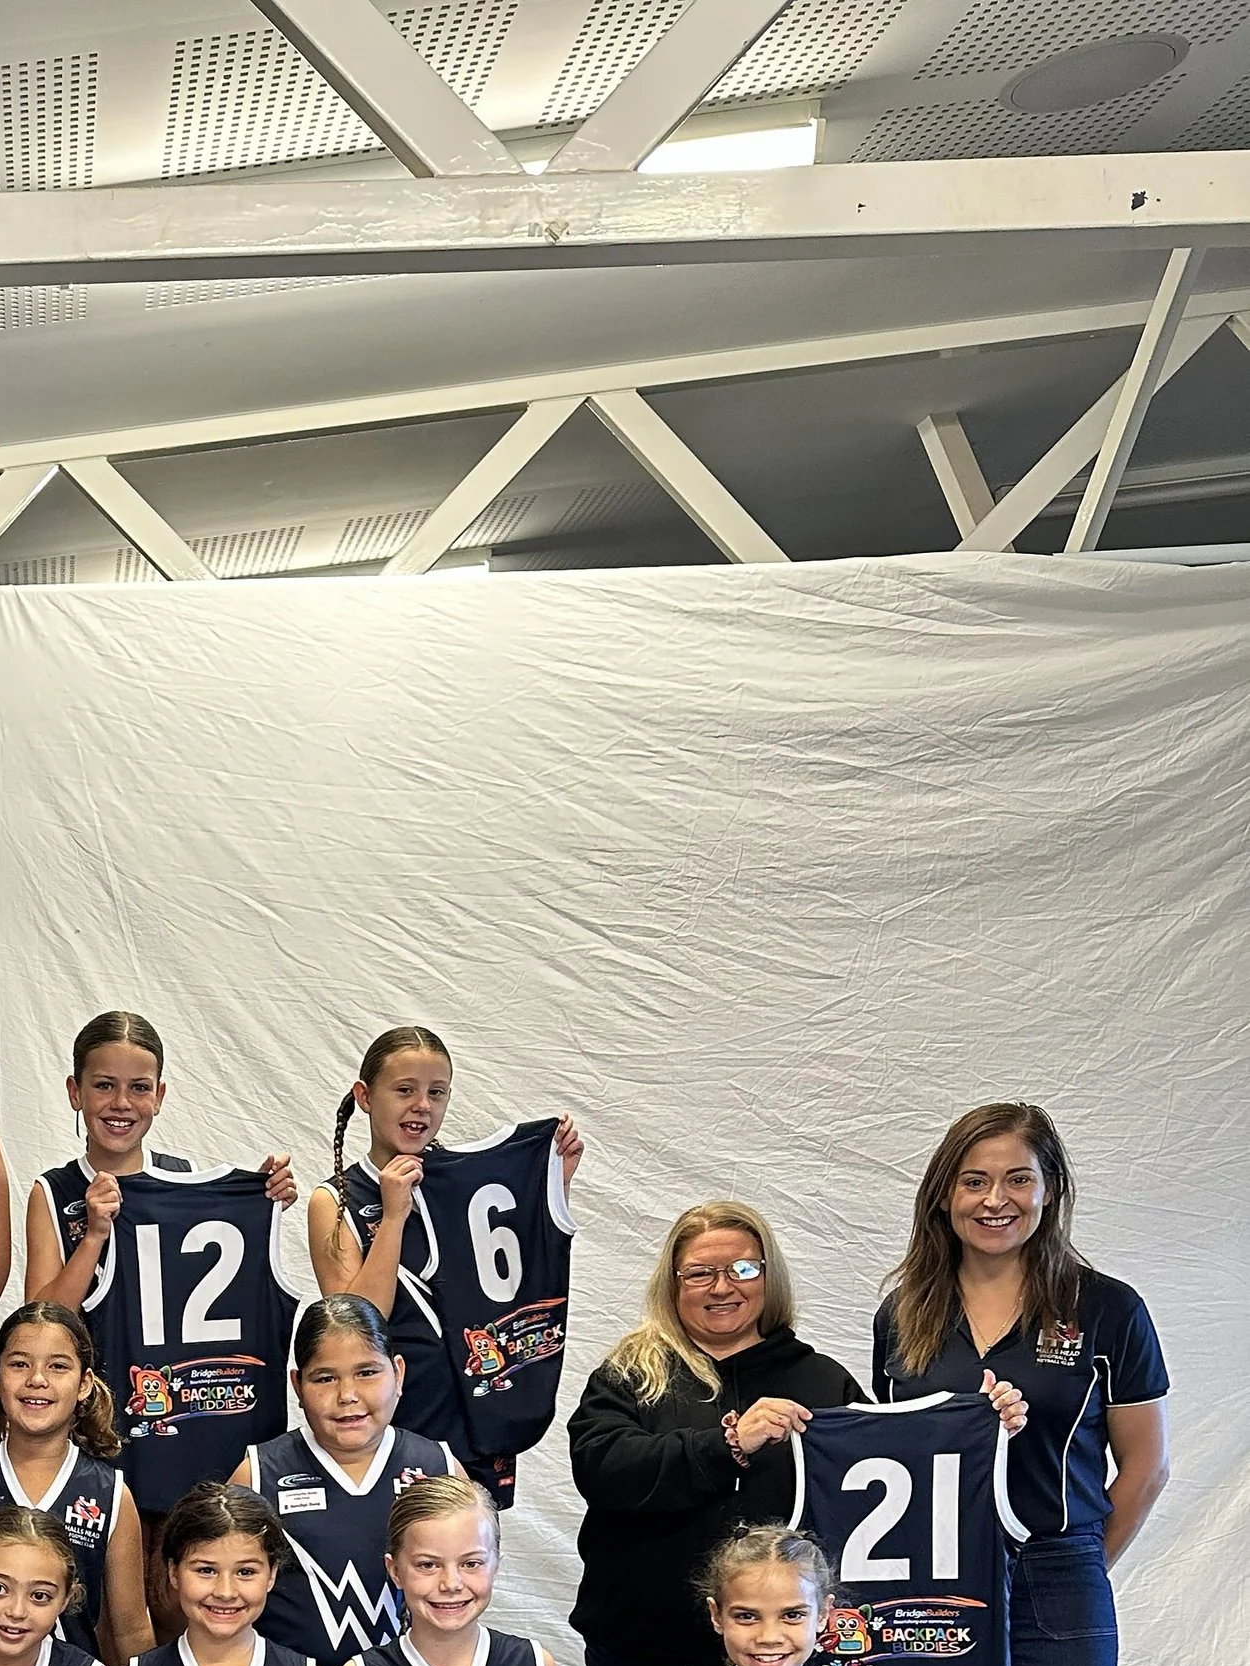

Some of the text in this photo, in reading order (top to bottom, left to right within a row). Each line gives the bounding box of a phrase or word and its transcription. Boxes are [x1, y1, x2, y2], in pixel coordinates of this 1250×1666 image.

[468, 1183, 522, 1302] 6
[135, 1220, 245, 1346] 12
[191, 1368, 245, 1378] BridgeBuilders
[181, 1385, 255, 1403] BACKPACK
[190, 1398, 247, 1412] BUDDIES
[840, 1454, 960, 1582] 21
[65, 1524, 84, 1535] HALLS
[895, 1609, 960, 1618] BridgeBuilders
[882, 1627, 971, 1642] BACKPACK
[893, 1641, 961, 1653] BUDDIES
